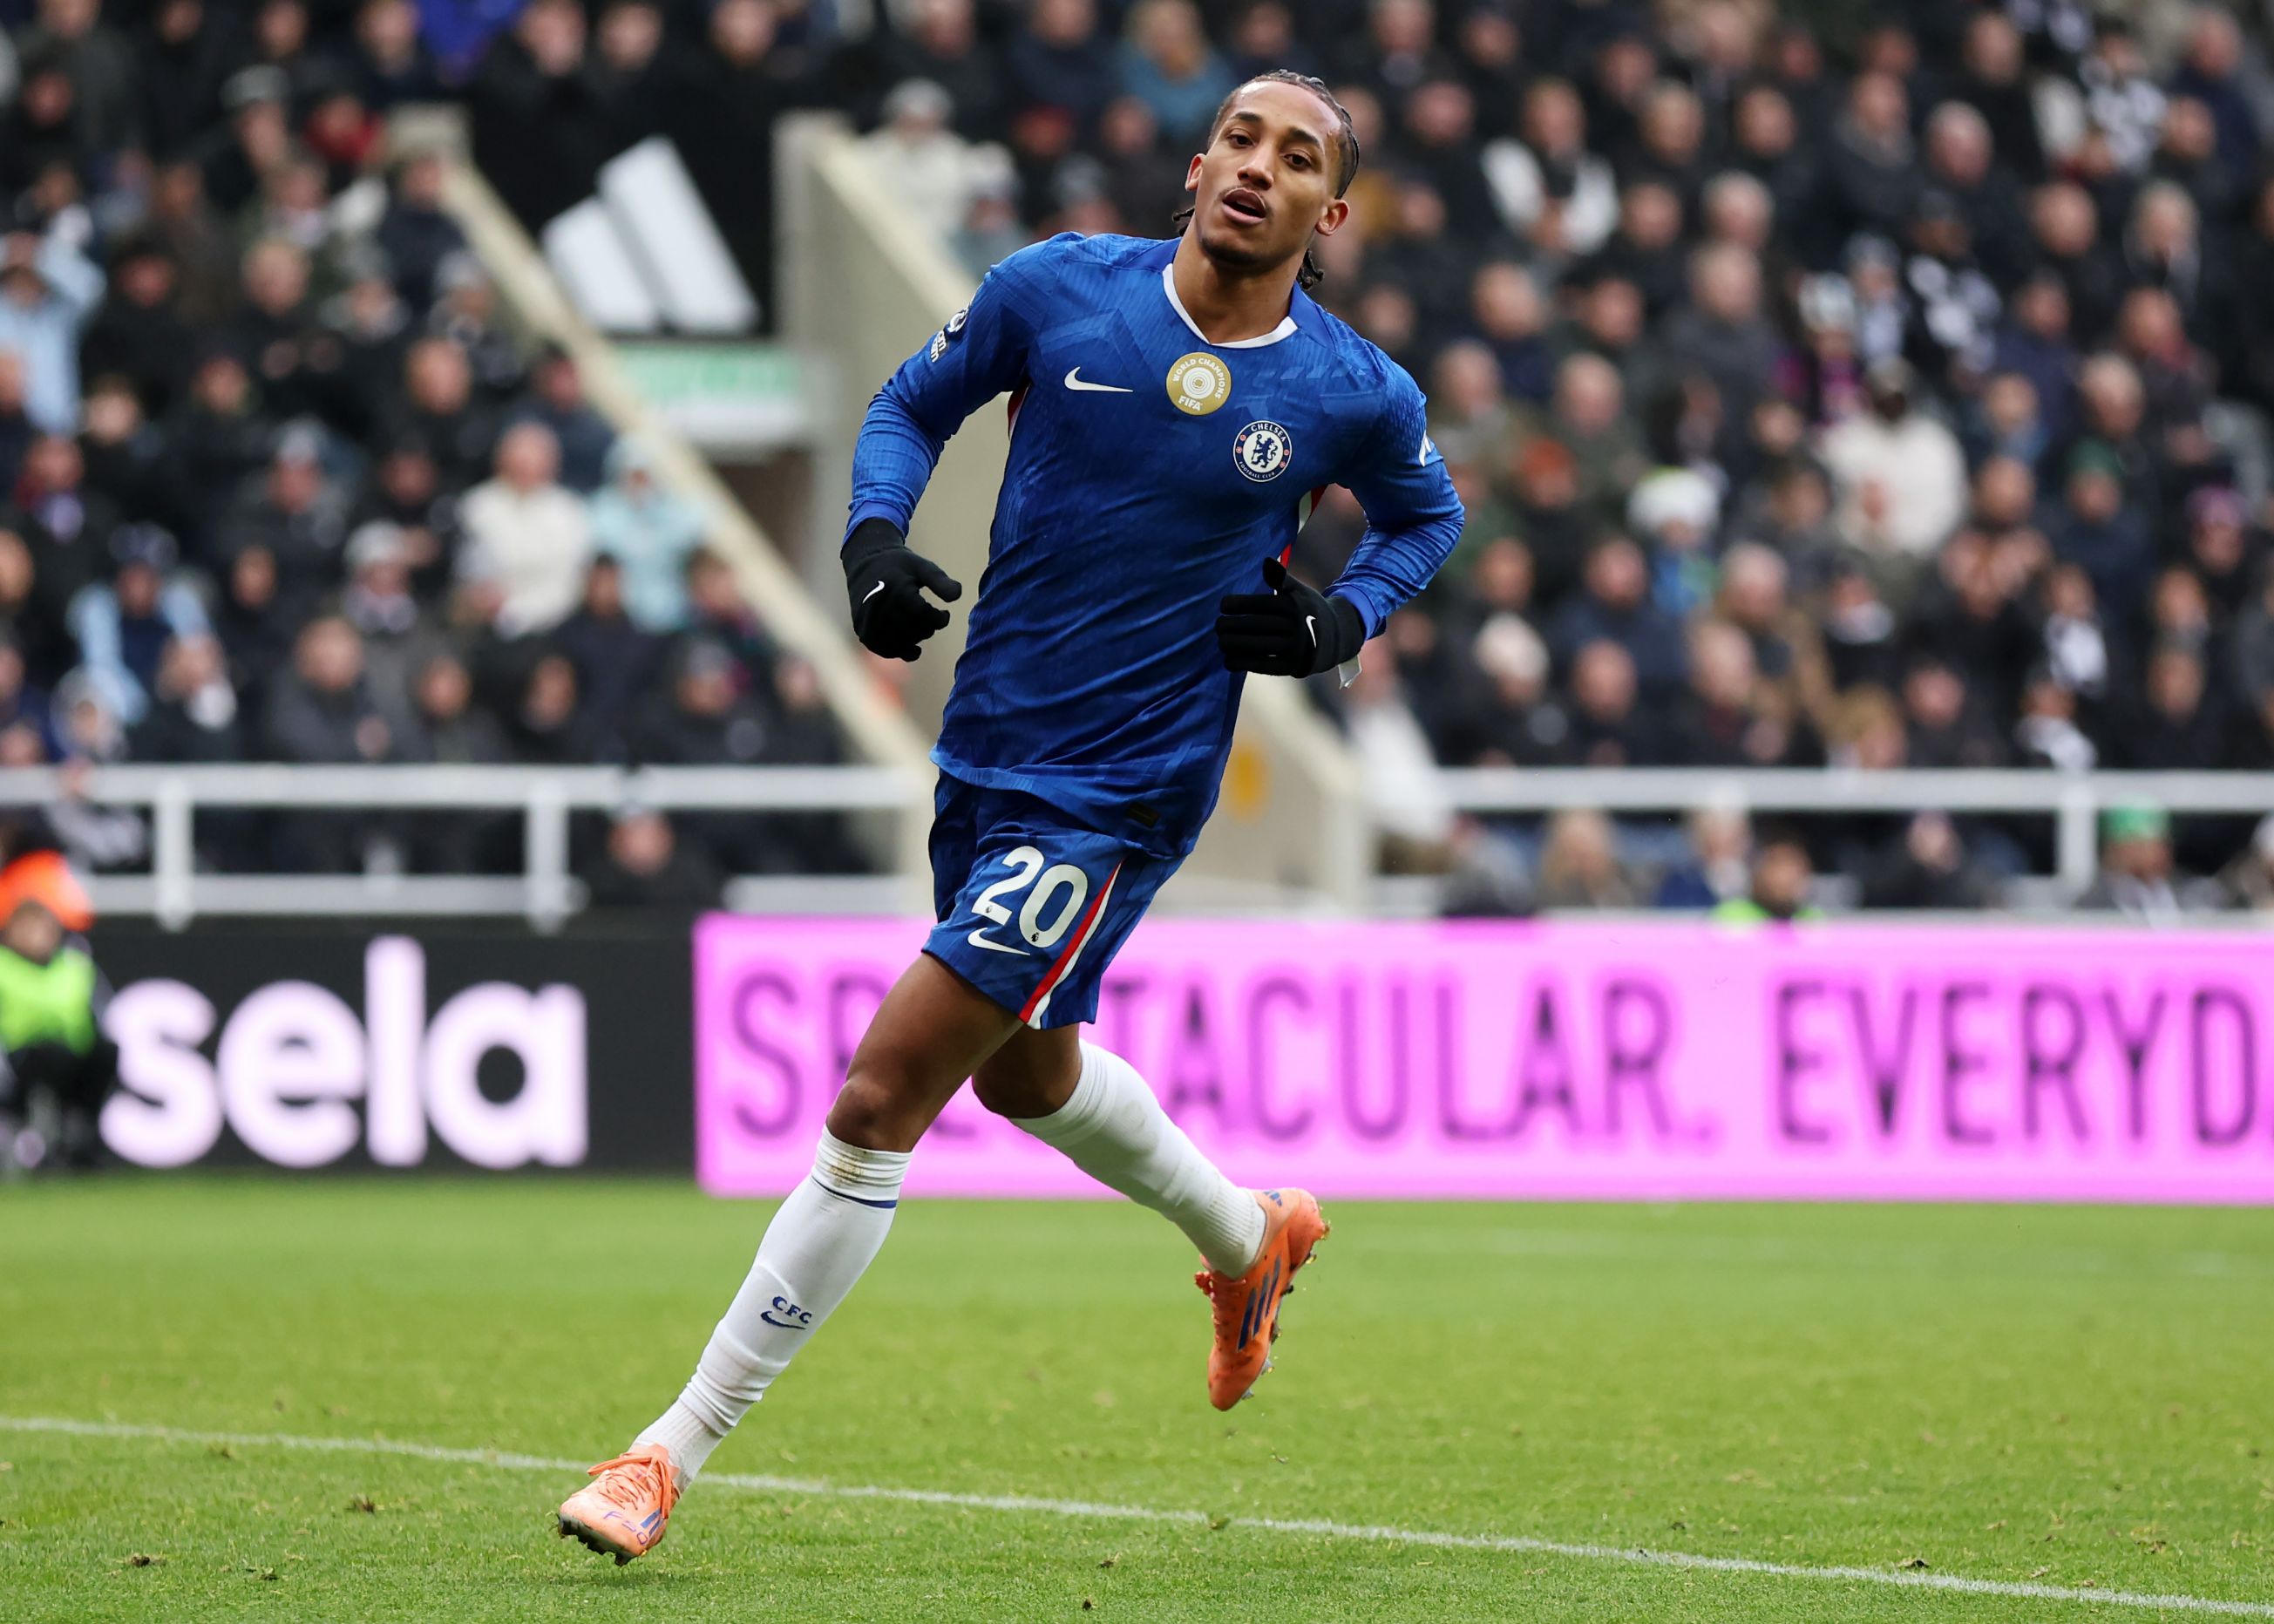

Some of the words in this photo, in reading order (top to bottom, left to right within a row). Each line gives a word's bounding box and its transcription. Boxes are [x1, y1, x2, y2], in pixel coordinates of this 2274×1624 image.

[1172, 358, 1197, 382] WORLD
[1198, 357, 1225, 399] CHAMPIONS
[1178, 395, 1202, 411] FIFA
[1251, 423, 1286, 442] CHELSEA
[971, 846, 1089, 948] 20
[99, 934, 587, 1169] sela
[732, 974, 1717, 1143] STACULAR.
[1776, 982, 2274, 1145] EVERYD
[772, 1295, 812, 1324] CFC
